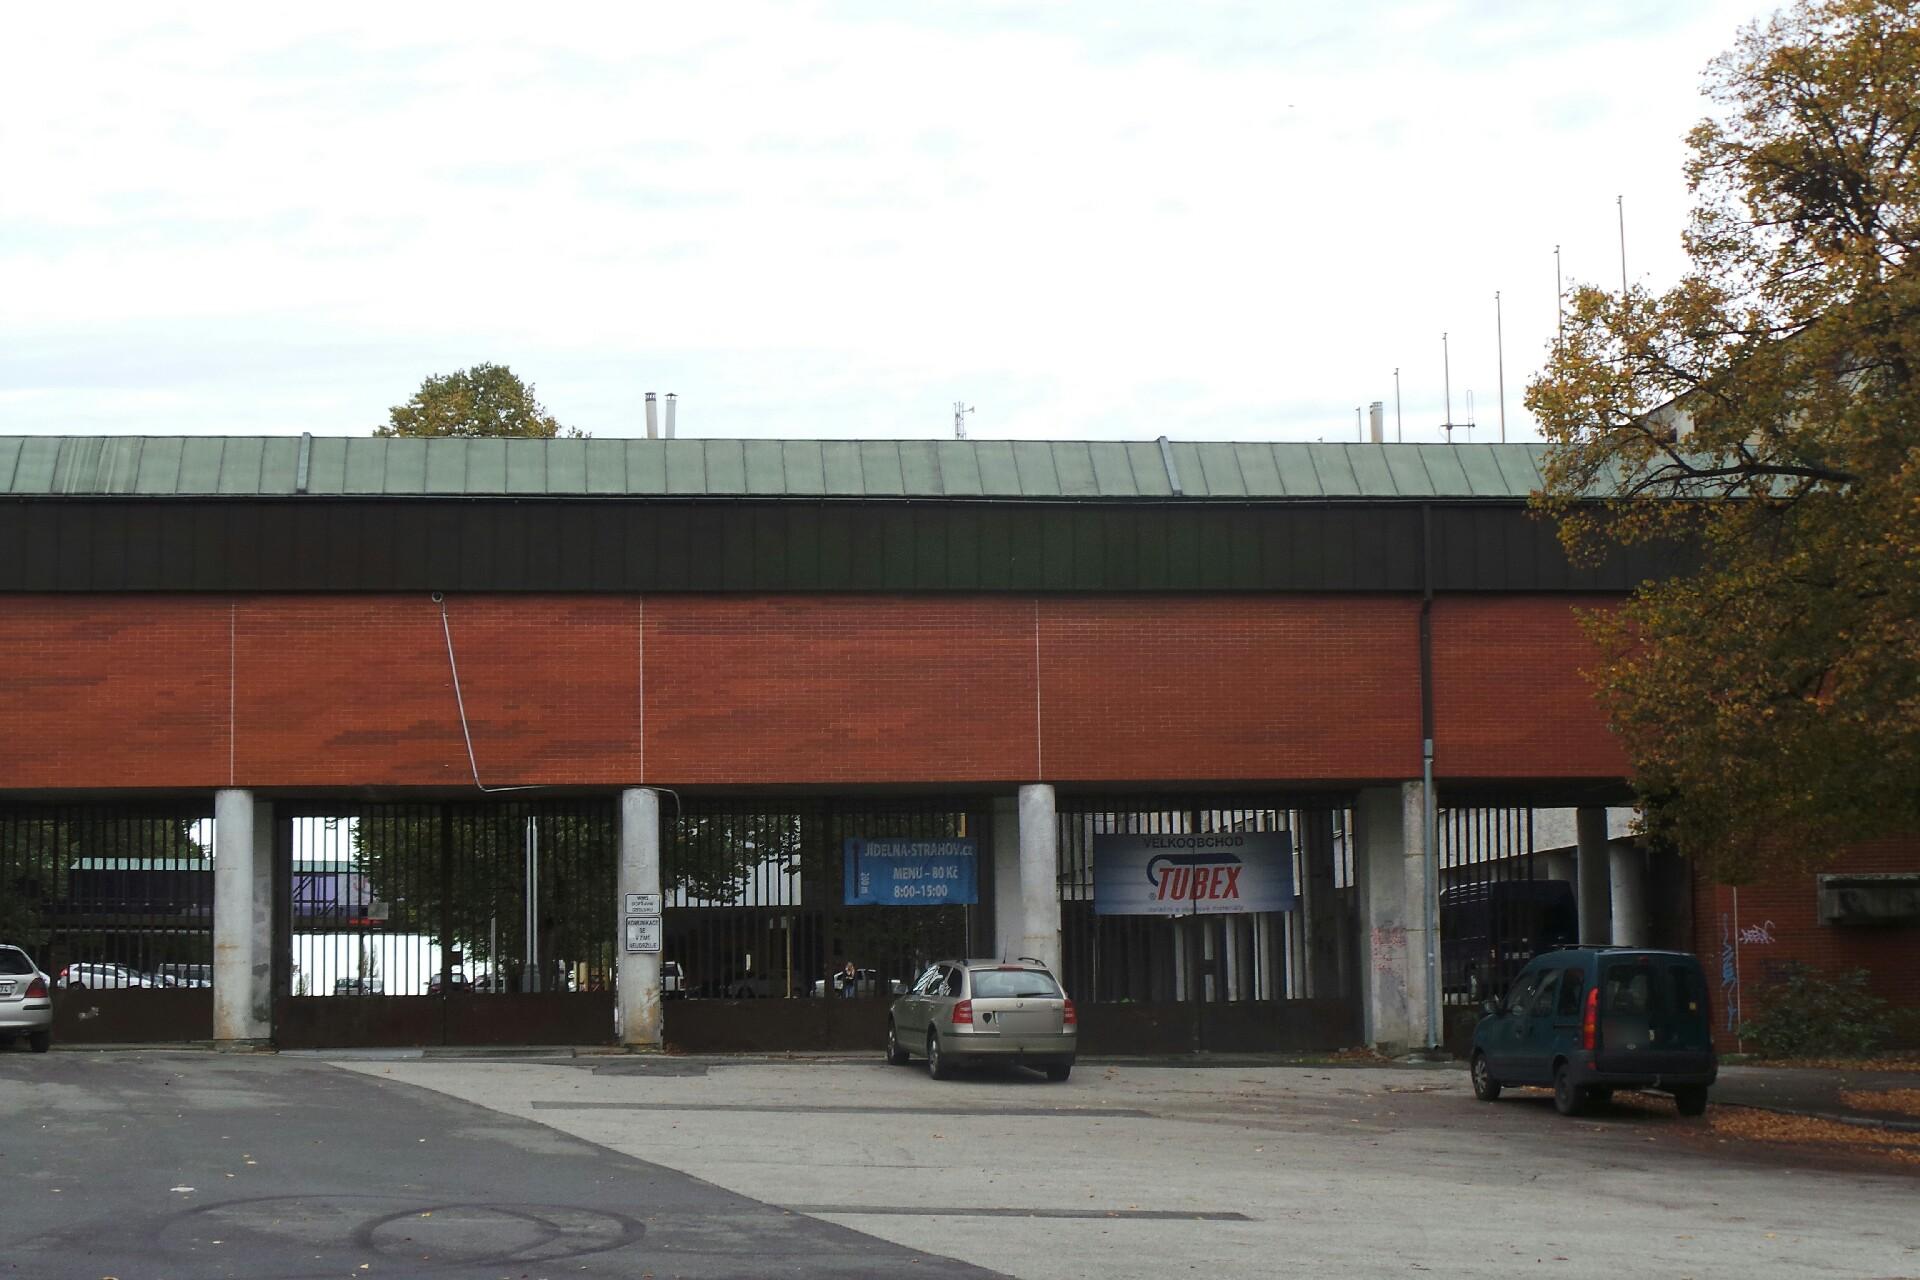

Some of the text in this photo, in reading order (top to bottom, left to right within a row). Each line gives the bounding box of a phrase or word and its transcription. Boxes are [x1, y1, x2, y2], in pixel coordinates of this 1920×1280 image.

[1145, 836, 1244, 849] VELKOOBCHOD
[932, 866, 943, 879] 80
[946, 864, 959, 879] Kč
[1158, 866, 1242, 900] TUBEX
